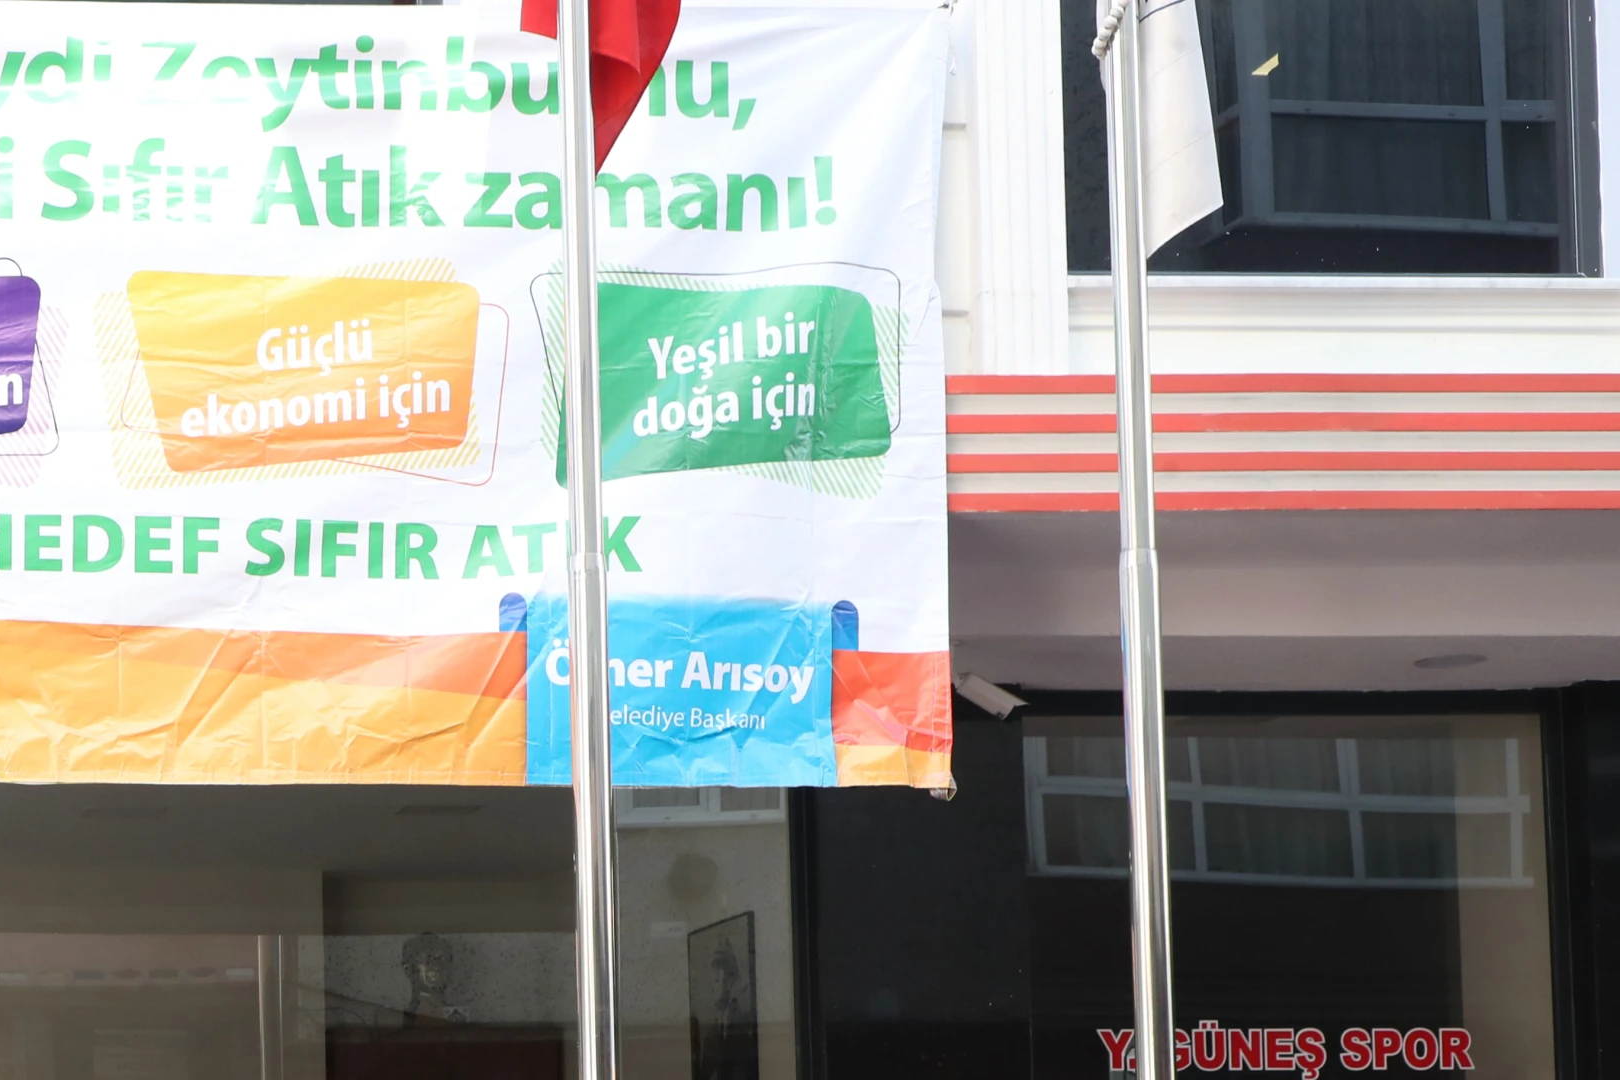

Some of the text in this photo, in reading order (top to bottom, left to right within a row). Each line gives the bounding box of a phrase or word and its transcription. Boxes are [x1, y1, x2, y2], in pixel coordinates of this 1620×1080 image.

[141, 35, 757, 131] Zeytinbuu,
[41, 138, 228, 222] Sıfır
[250, 144, 447, 229] Atık
[462, 155, 838, 233] zamanı!
[256, 317, 374, 375] Güçlü
[647, 312, 816, 382] Yeşil bir
[180, 373, 452, 438] ekonomi için
[633, 374, 817, 440] doğa için
[244, 516, 440, 580] SIFIR
[461, 515, 643, 580] ATK
[682, 651, 814, 704] Arısoy
[609, 704, 765, 732] elediye Başkanı
[1341, 1027, 1475, 1071] SPOR
